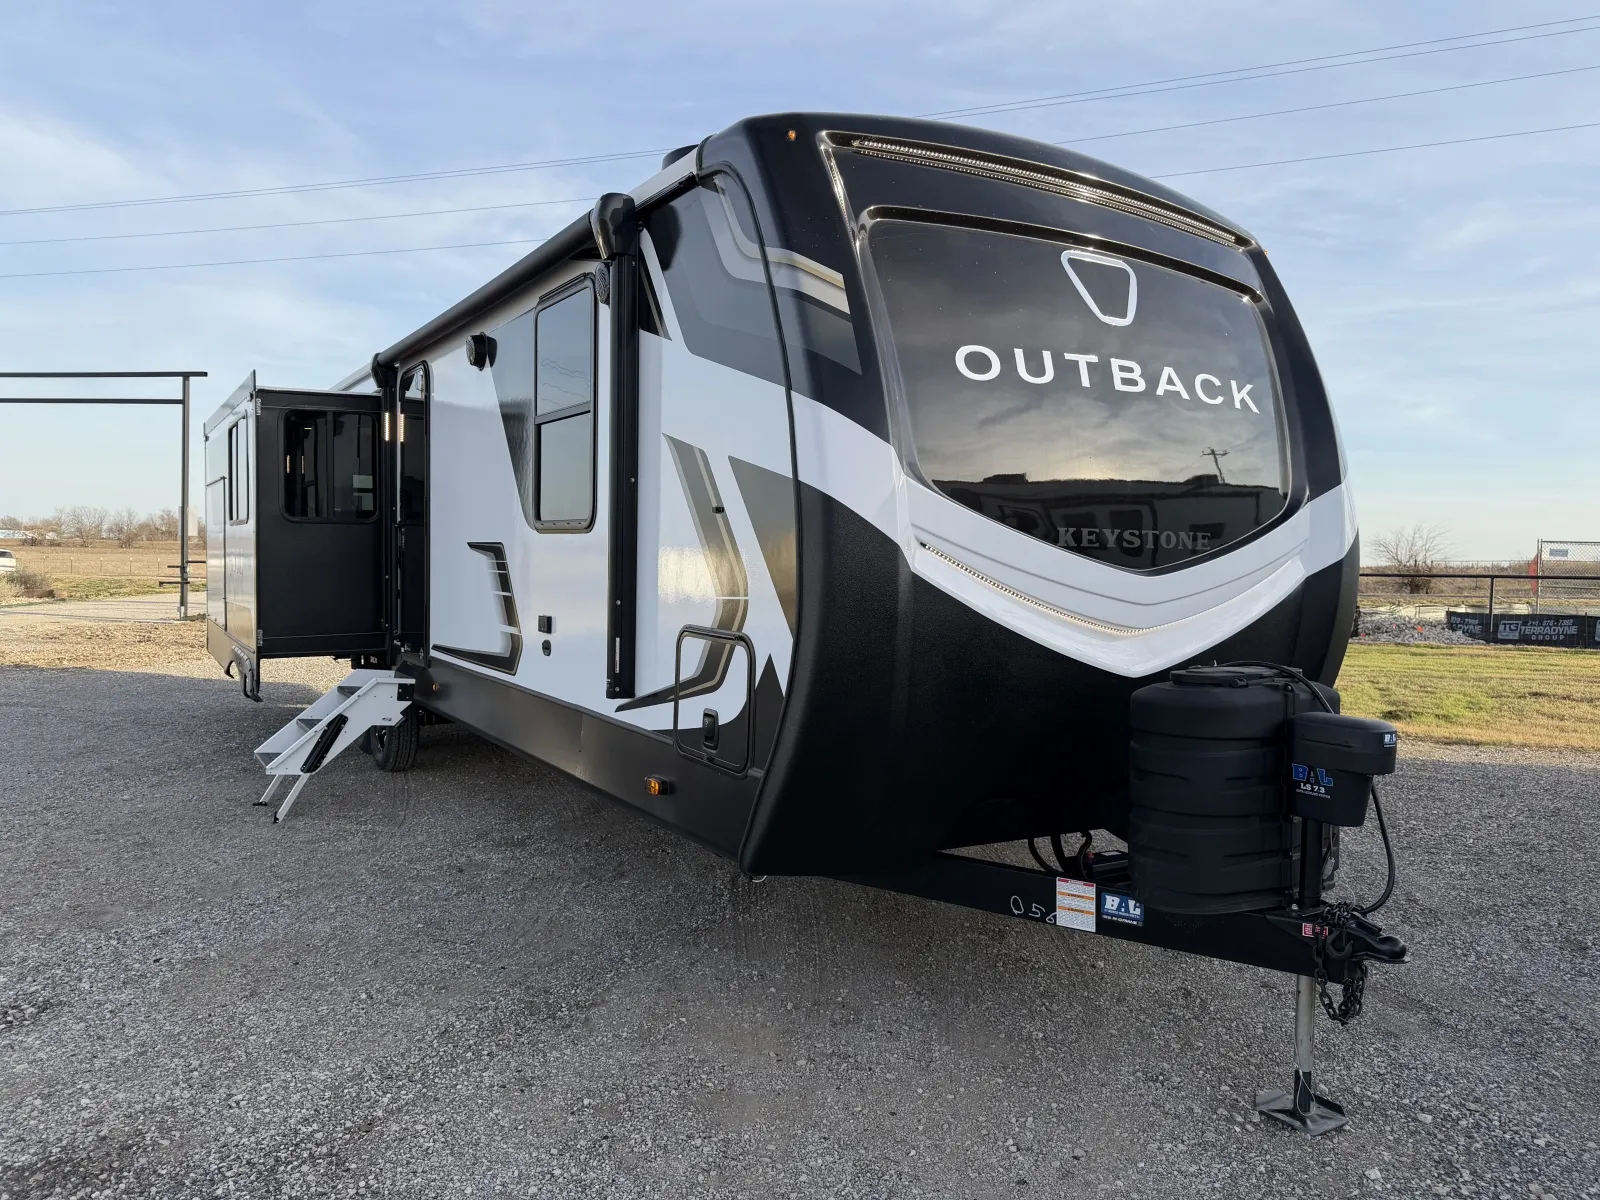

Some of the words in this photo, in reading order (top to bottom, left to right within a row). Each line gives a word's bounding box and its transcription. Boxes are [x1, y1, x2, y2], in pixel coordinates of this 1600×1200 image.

[955, 345, 1260, 414] OUTBACK
[1056, 527, 1212, 550] KEYSTONE
[1520, 625, 1578, 635] TERRADYNE
[1292, 763, 1334, 787] BAL
[1300, 782, 1312, 791] LS
[1104, 894, 1141, 915] BAL
